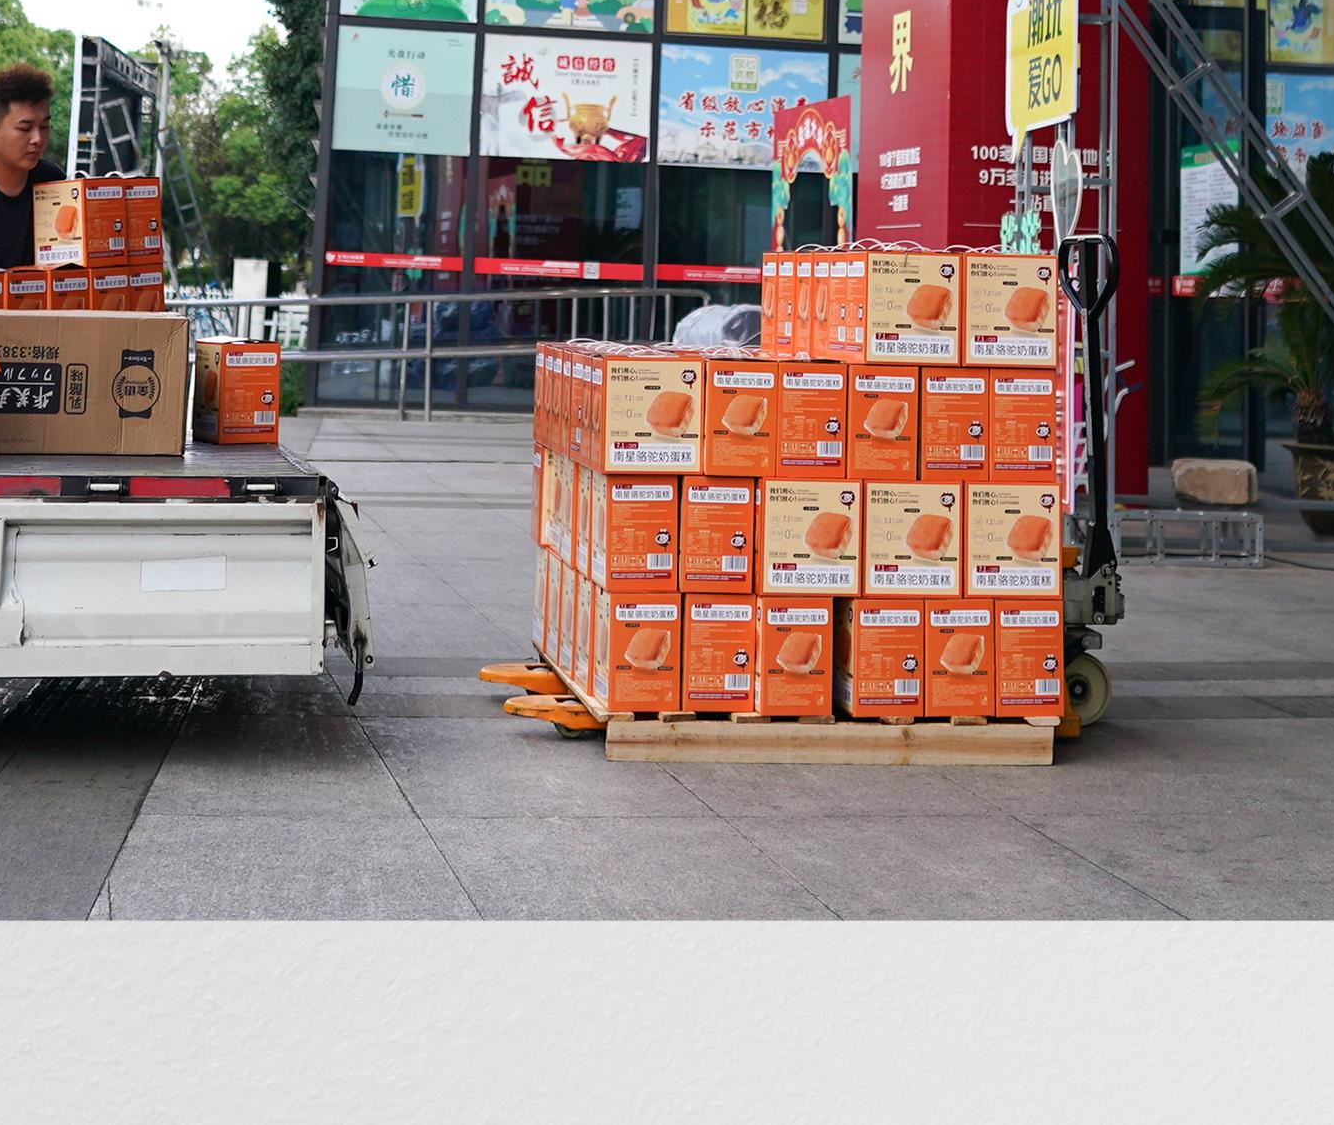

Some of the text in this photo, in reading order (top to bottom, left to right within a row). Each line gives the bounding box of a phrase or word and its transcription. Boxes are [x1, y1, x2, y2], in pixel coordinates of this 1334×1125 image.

[391, 74, 414, 98] 惜
[875, 342, 951, 355] 南星骆驼奶蛋糕
[974, 344, 1049, 358] 南星骆驼奶蛋糕
[68, 369, 84, 410] 乳酪味
[614, 451, 692, 463] 南星骆驼奶蛋糕
[771, 572, 851, 585] 南星骆驼奶蛋糕
[874, 575, 951, 586] 南星骆驼奶蛋糕
[976, 575, 1052, 586] 南星骆驼奶蛋糕
